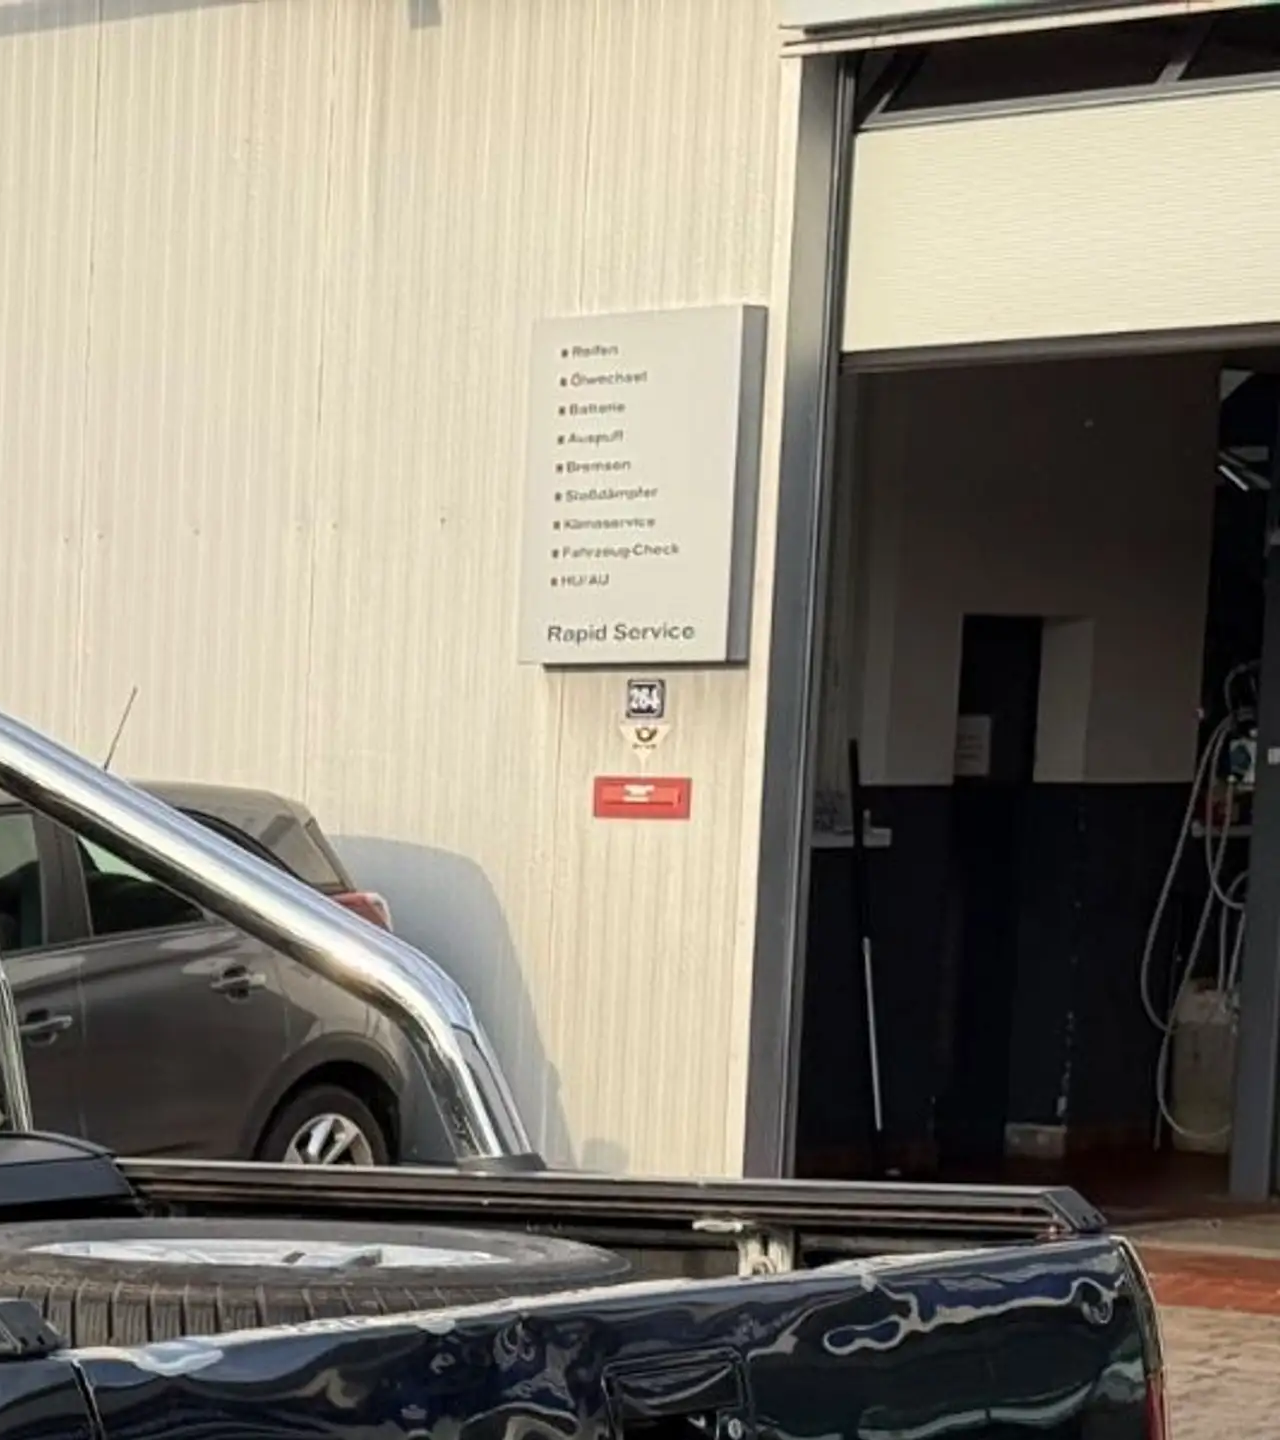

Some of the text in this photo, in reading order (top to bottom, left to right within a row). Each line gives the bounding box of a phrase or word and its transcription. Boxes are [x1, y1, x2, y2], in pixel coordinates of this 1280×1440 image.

[566, 460, 631, 473] Bremsen
[547, 622, 695, 645] Rapid Service
